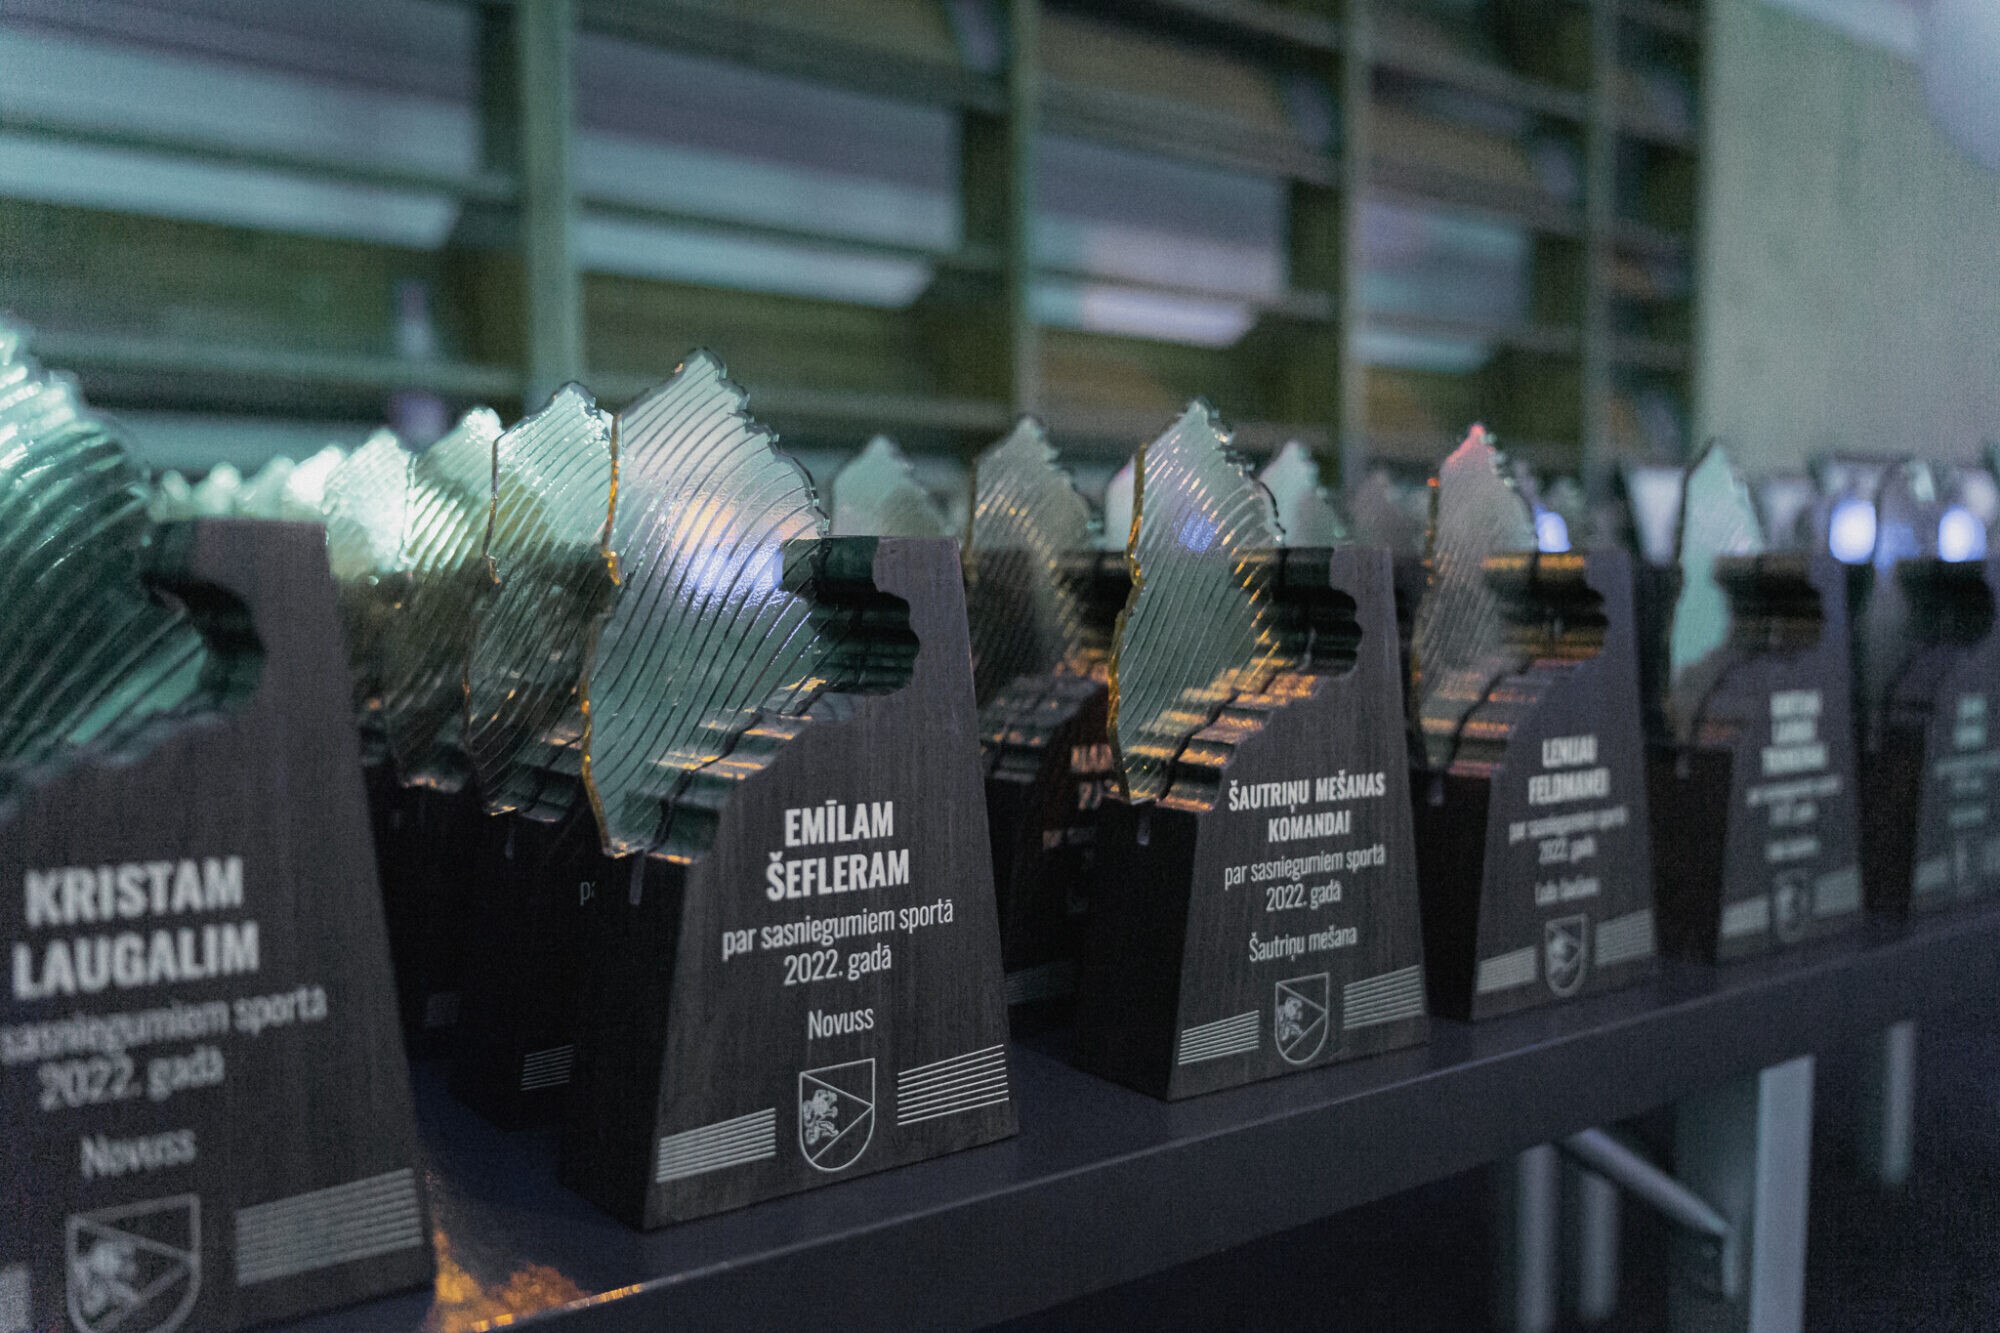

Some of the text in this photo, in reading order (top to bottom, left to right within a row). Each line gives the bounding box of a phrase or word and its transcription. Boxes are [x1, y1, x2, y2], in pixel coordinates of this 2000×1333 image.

[1228, 769, 1386, 813] ŠAUTRIŅU MEŠANAS
[784, 799, 894, 847] EMĪLAM
[1267, 809, 1351, 843] KOMANDAI
[766, 849, 910, 901] ŠEFLERAM
[1224, 843, 1386, 891] par sasniegumiem sportā
[24, 855, 244, 928] KRISTAM
[1265, 879, 1341, 912] 2022. gadā
[722, 899, 954, 961] par sasniegumiem sportā
[1248, 924, 1358, 962] Šautriņu mešana
[13, 920, 260, 999] LAUGALIM
[783, 944, 893, 986] 2022. gadā
[807, 1008, 875, 1040] Novuss
[80, 1129, 197, 1179] Novuss
